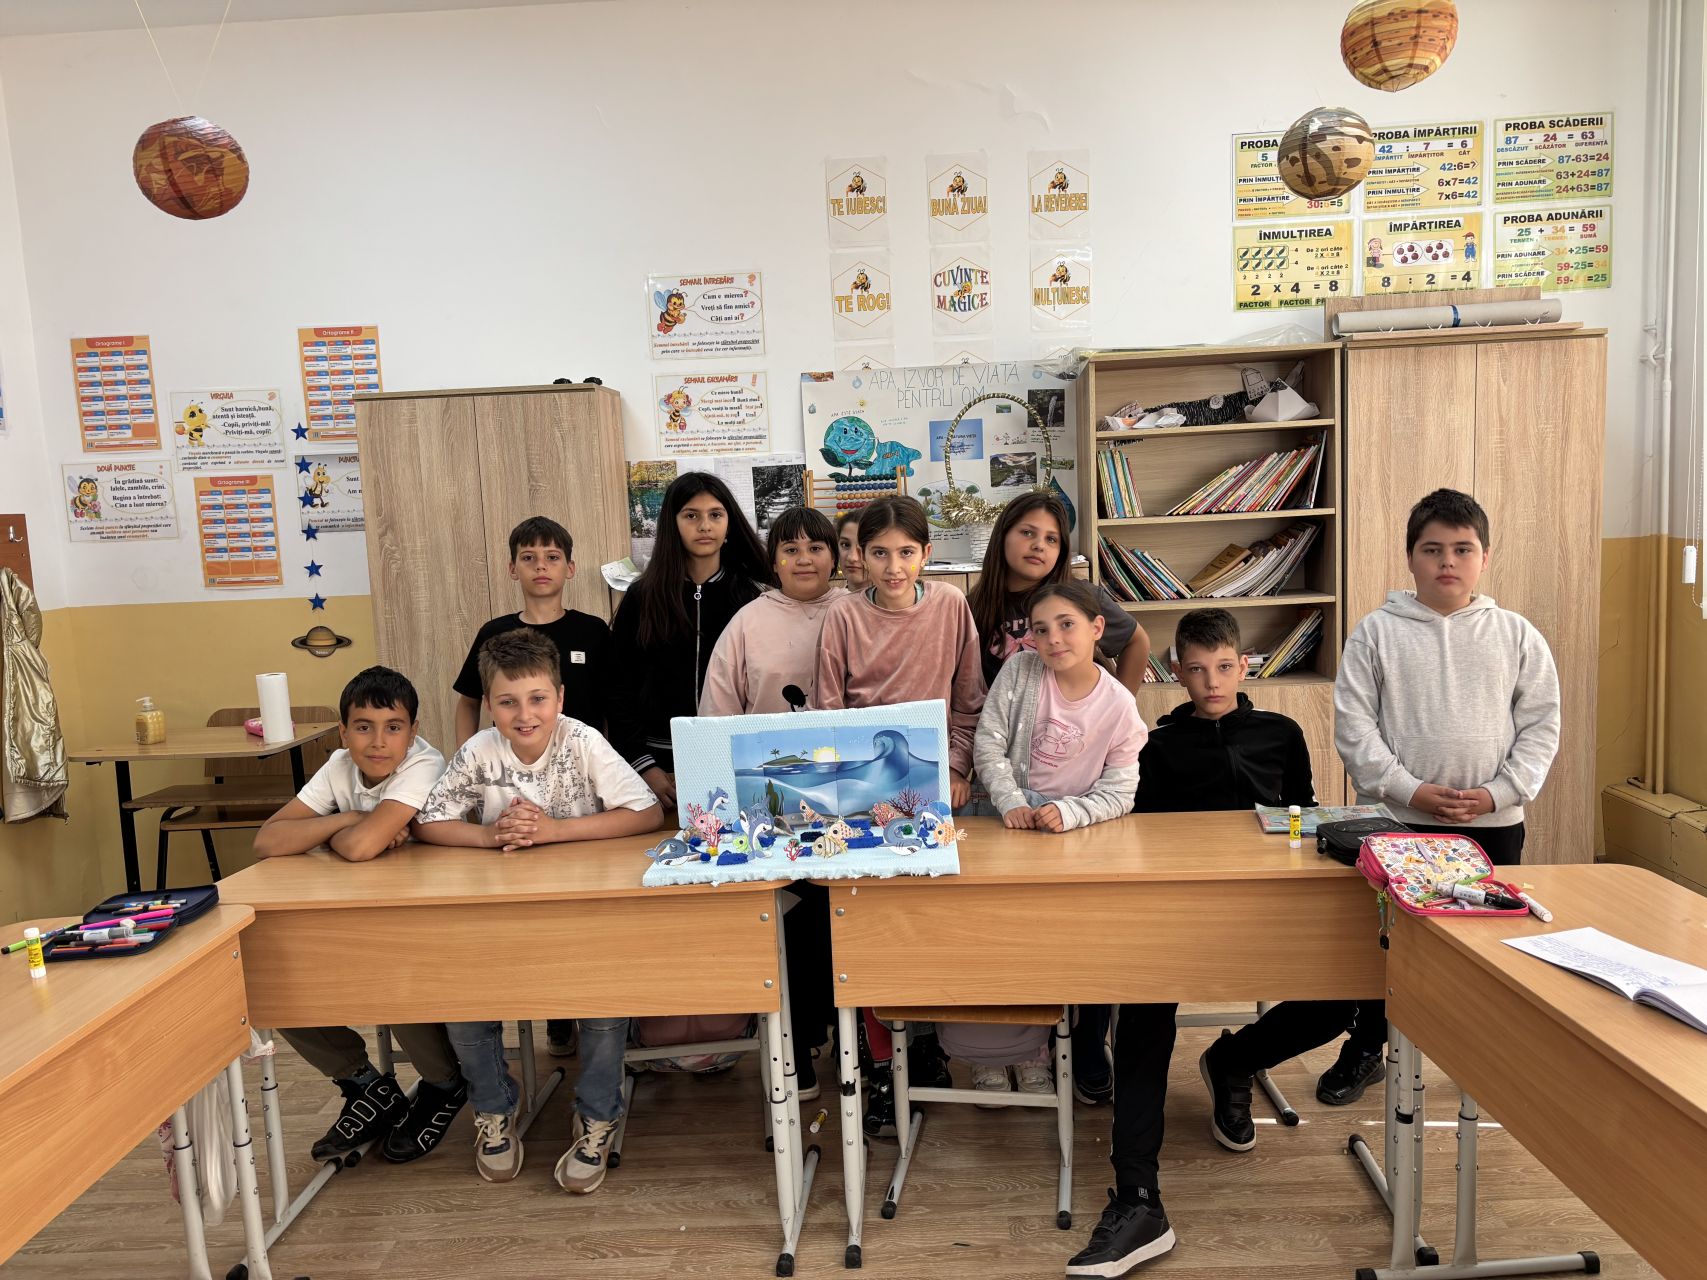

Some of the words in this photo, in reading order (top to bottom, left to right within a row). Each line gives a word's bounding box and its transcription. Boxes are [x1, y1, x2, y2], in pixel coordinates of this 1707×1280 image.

[1505, 121, 1546, 131] PROBA
[1549, 116, 1604, 128] SCĂDERII
[1373, 131, 1410, 141] PROBA
[1504, 136, 1519, 145] 87
[1543, 133, 1558, 142] 24
[1581, 131, 1595, 140] 63
[1240, 139, 1278, 149] PROBA
[1379, 145, 1393, 153] 42
[1423, 142, 1431, 150] 7
[1460, 139, 1468, 148] 6
[1261, 152, 1269, 161] 5
[1558, 153, 1610, 164] 87-63=24
[1556, 168, 1611, 180] 63+24=87
[1556, 183, 1610, 194] 24+63=87
[831, 199, 844, 216] TE
[1032, 195, 1043, 212] LA
[1503, 214, 1543, 224] PROBA
[1546, 209, 1603, 221] ADUNĂRII
[1517, 228, 1531, 237] 25
[1582, 223, 1596, 232] 59
[934, 265, 990, 287] CUVINTE
[1381, 276, 1391, 288] 8
[1426, 273, 1436, 285] 2
[1462, 270, 1472, 282] 4
[1251, 285, 1261, 296] 2
[1290, 282, 1301, 294] 4
[1328, 280, 1339, 292] 8
[835, 296, 853, 313] TE
[857, 293, 890, 312] ROG!
[937, 293, 990, 312] MAGICE
[1239, 300, 1270, 308] FACTOR
[1280, 298, 1311, 306] FACTOR
[869, 370, 898, 392] APA
[897, 387, 953, 409] PENTRU
